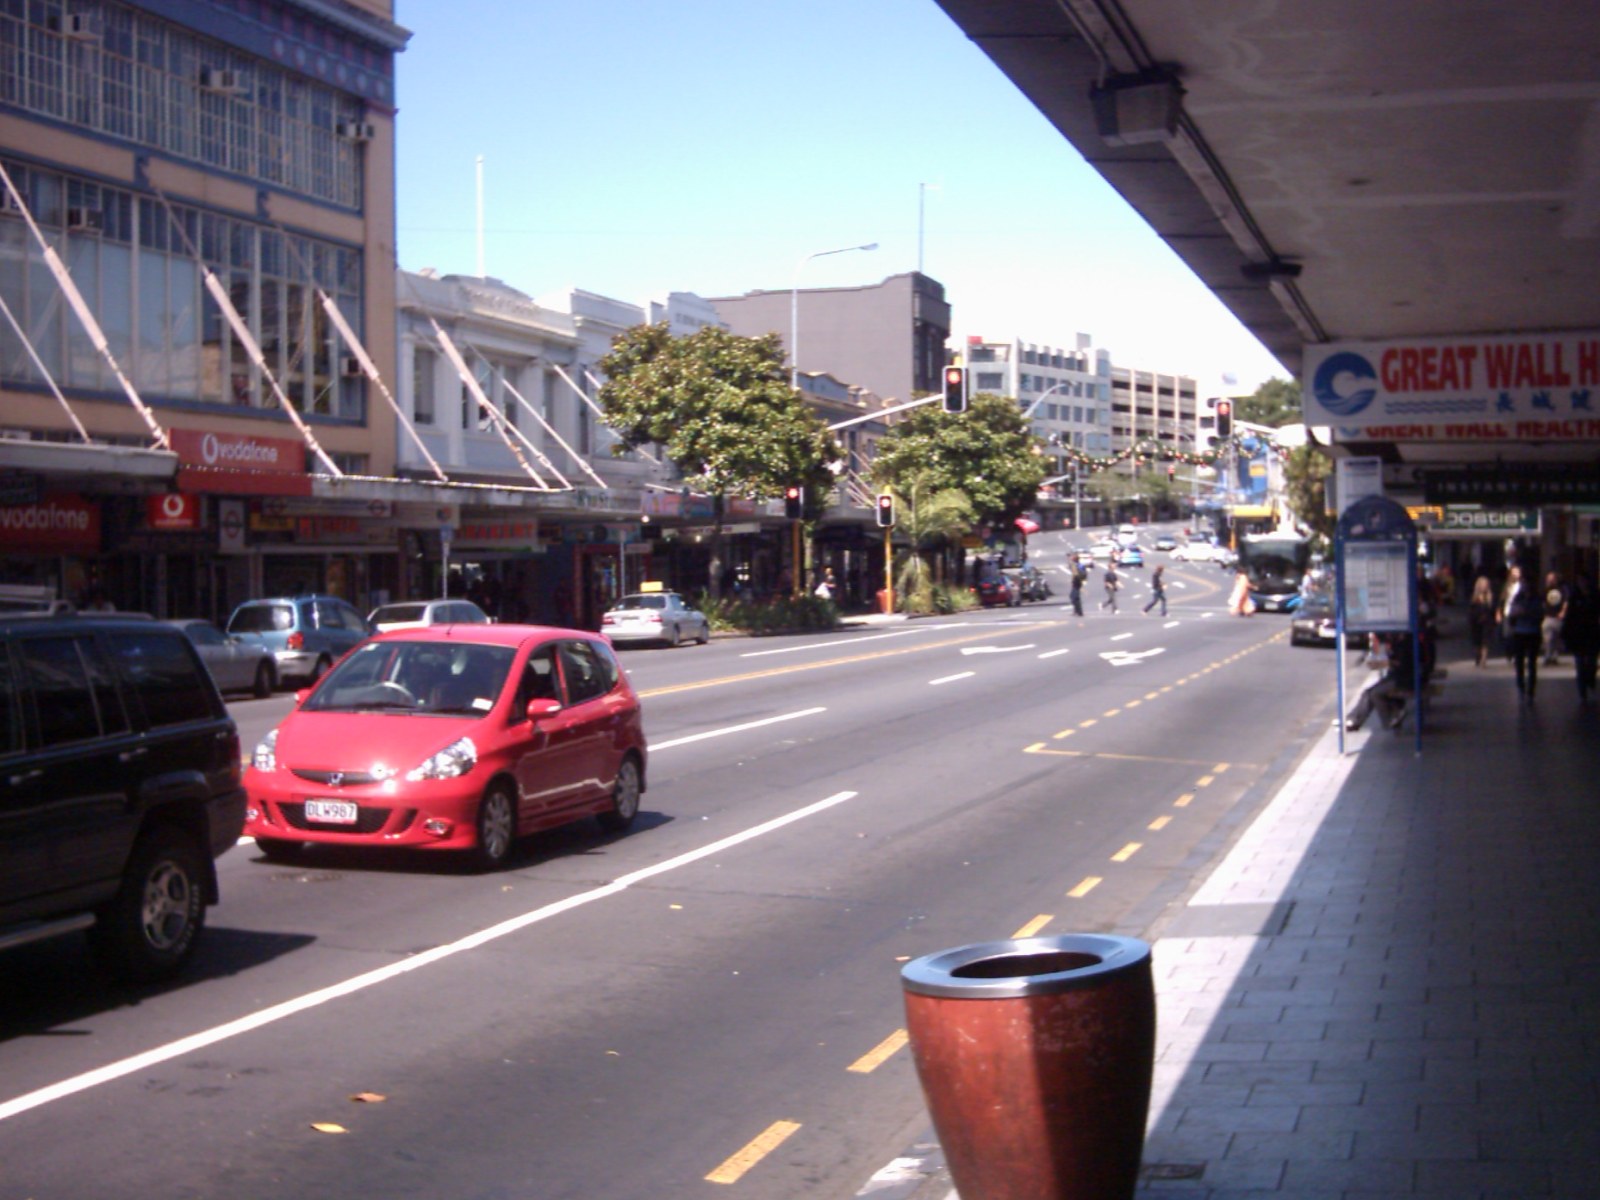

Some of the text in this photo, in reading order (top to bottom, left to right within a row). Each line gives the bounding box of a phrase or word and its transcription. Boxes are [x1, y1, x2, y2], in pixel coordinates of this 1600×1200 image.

[1380, 345, 1477, 393] GREAT
[1485, 341, 1572, 390] WALL
[218, 440, 280, 463] vodafone
[0, 502, 90, 530] vodafone
[306, 801, 356, 818] DLW987
